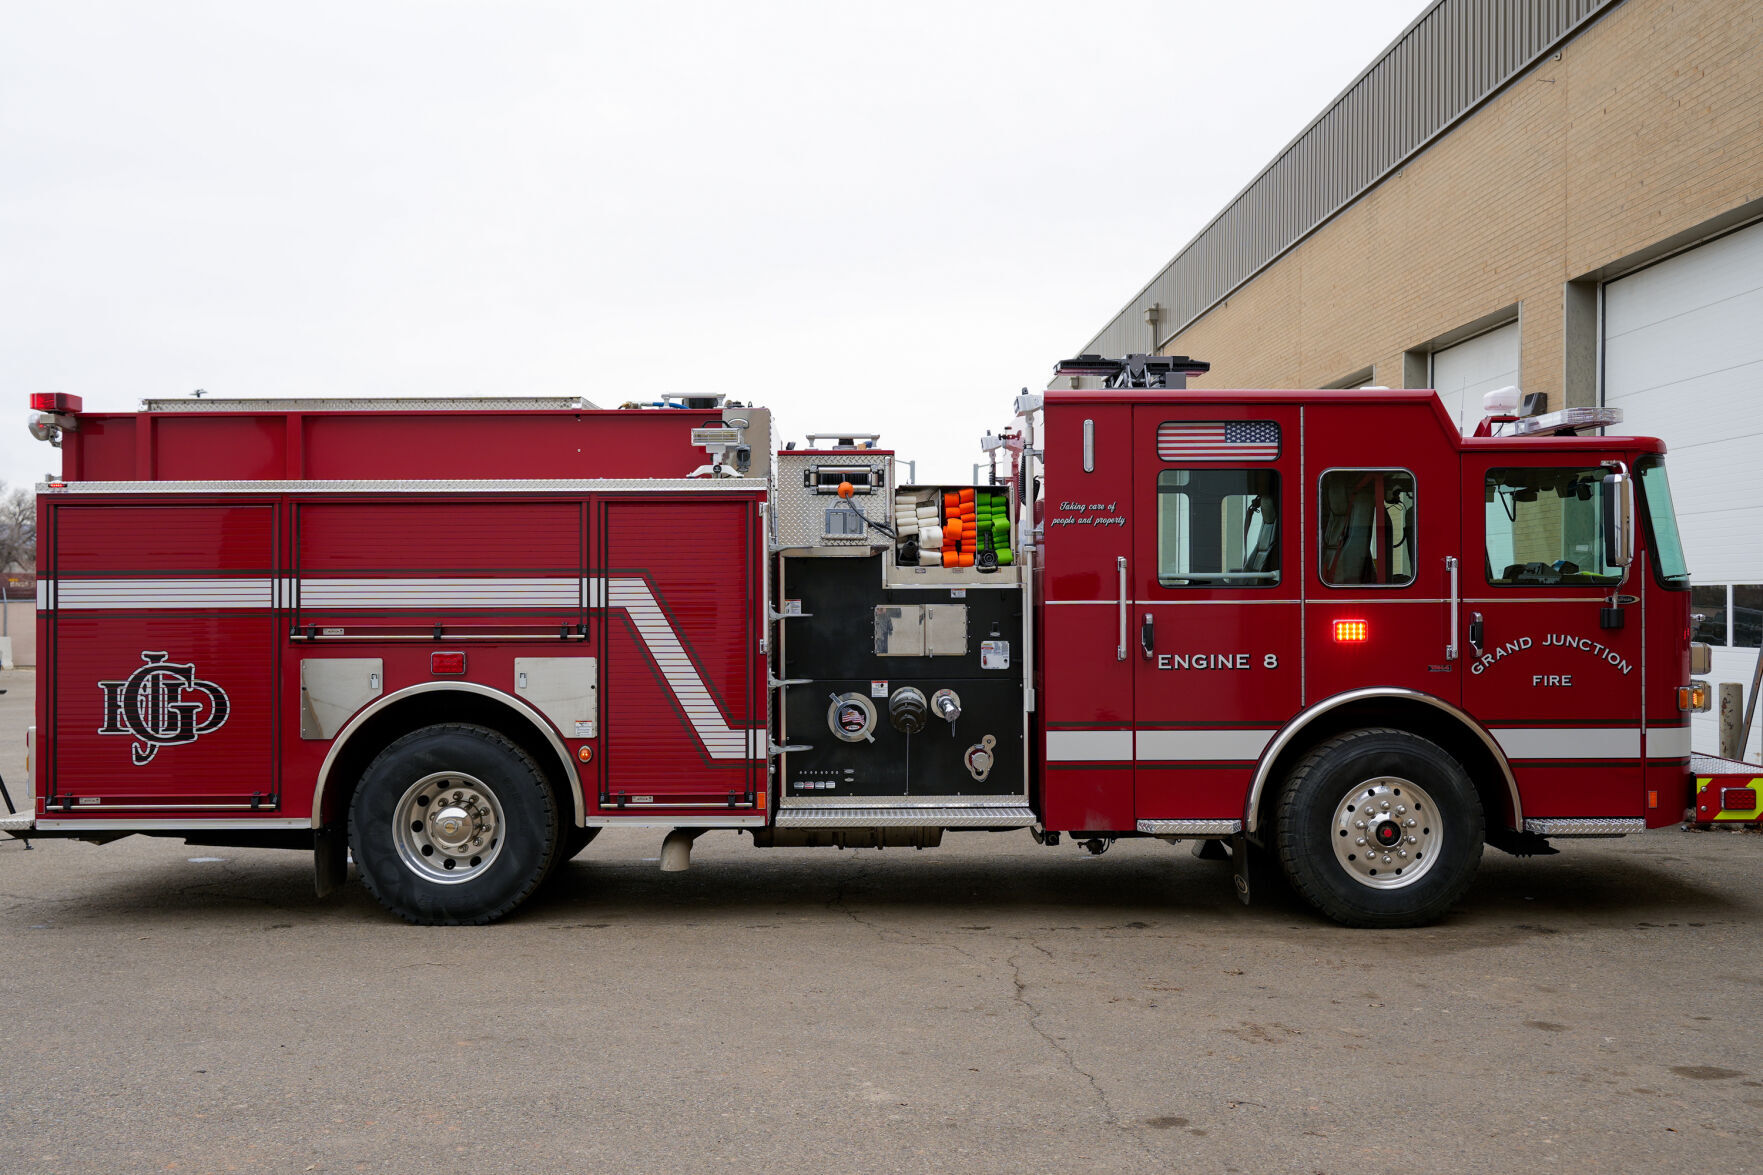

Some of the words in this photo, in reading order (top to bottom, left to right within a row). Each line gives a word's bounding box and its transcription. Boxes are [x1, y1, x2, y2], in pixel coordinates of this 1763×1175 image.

[1060, 501, 1086, 514] Taking
[1088, 503, 1106, 511] care
[1107, 501, 1116, 513] of
[1051, 515, 1075, 527] people
[1078, 515, 1093, 524] and
[1094, 515, 1126, 527] property
[1471, 636, 1534, 675] GRAND
[1542, 633, 1633, 675] JUNCTION
[1157, 653, 1251, 670] ENGINE
[1263, 653, 1279, 669] 8
[1532, 674, 1573, 687] FIRE
